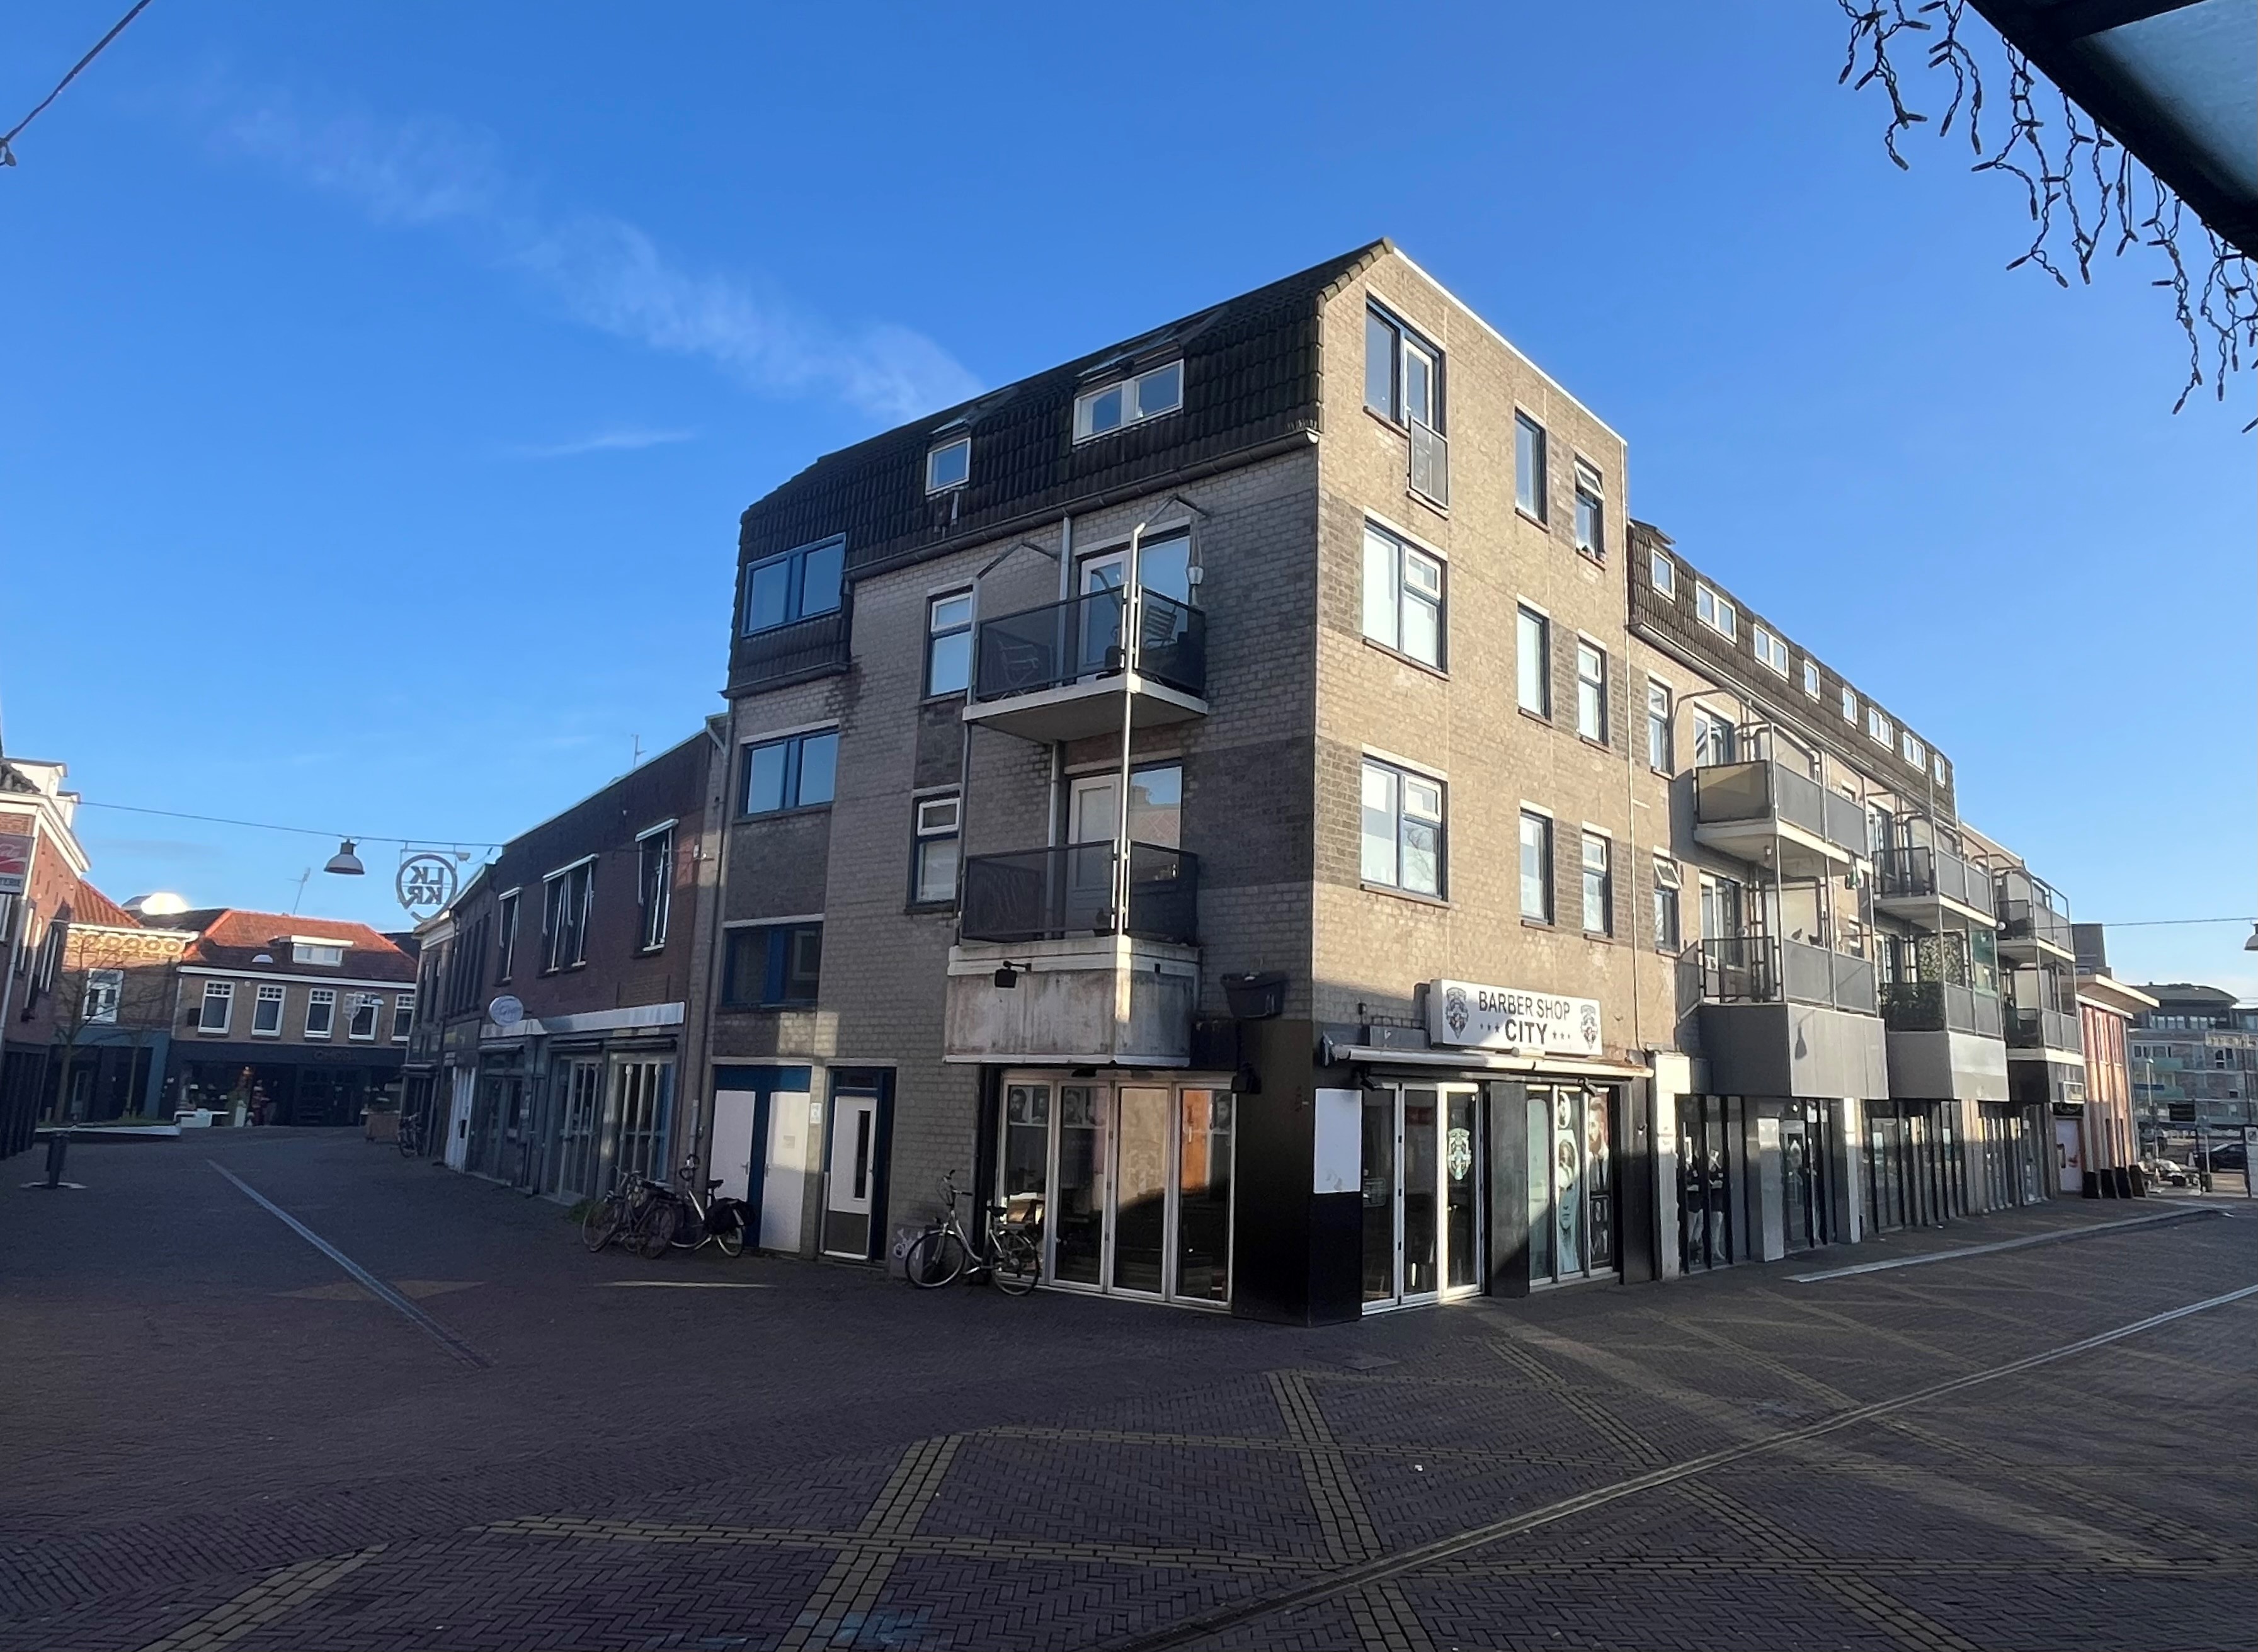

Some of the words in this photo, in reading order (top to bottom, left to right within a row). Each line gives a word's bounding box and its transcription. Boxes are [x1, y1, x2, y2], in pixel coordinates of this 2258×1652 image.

[1478, 990, 1532, 1017] BARBER
[1536, 998, 1570, 1021] SHOP
[1505, 1018, 1548, 1045] CITY
